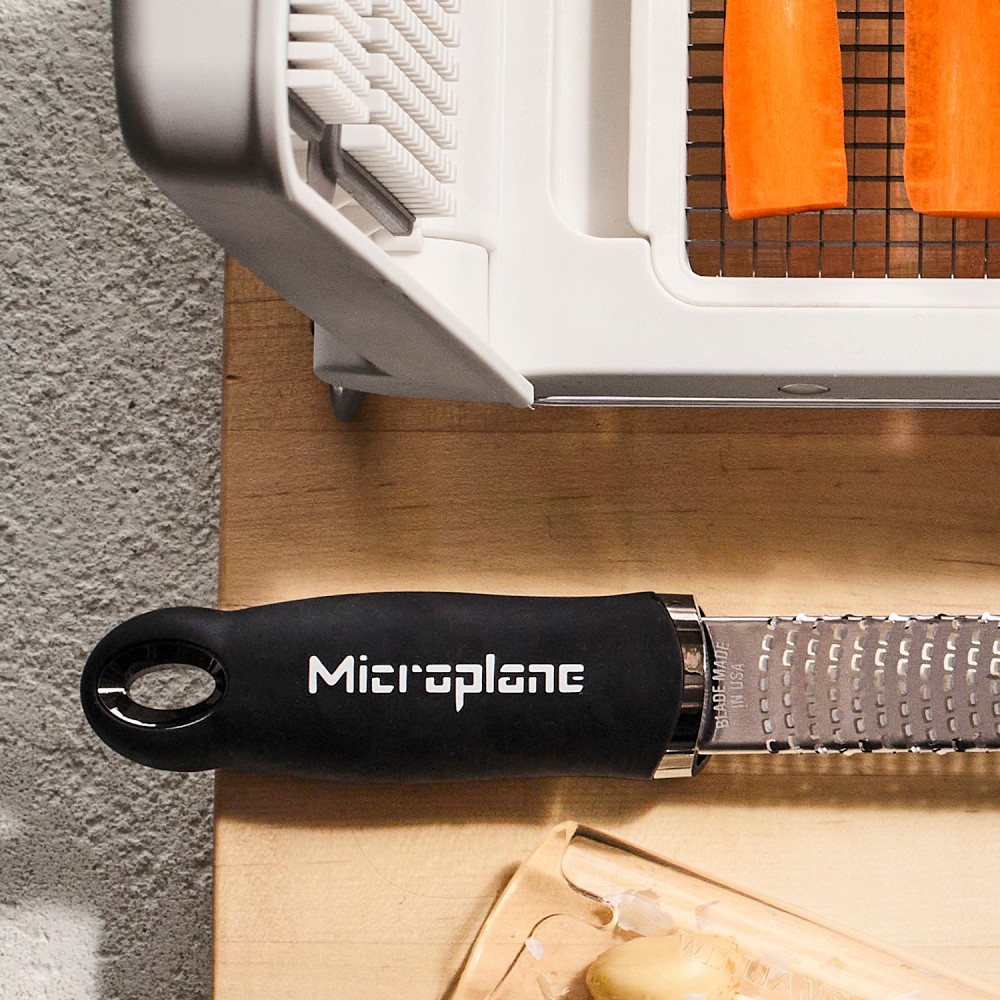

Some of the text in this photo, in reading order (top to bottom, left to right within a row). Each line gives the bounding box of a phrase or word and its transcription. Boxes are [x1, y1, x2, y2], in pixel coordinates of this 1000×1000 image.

[308, 653, 585, 713] Microplane
[712, 642, 730, 729] BLADE MADE
[730, 663, 745, 708] IN USA
